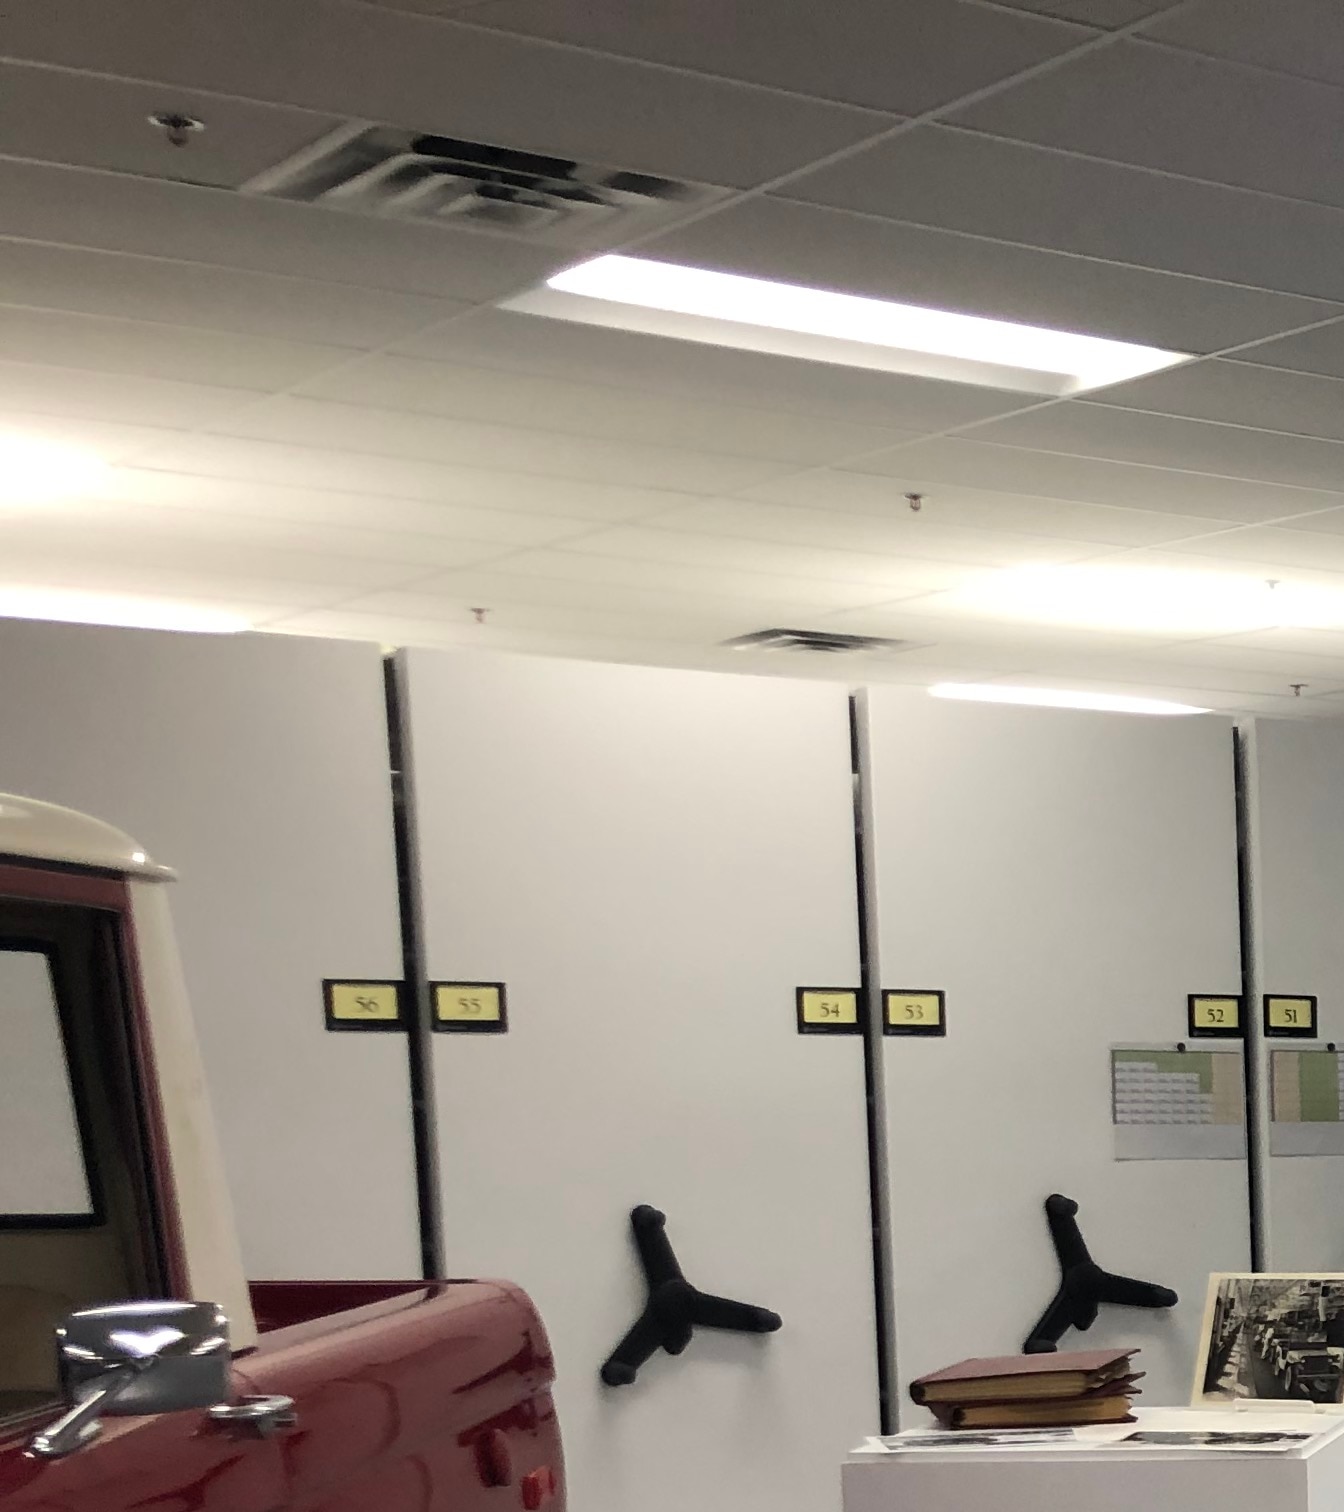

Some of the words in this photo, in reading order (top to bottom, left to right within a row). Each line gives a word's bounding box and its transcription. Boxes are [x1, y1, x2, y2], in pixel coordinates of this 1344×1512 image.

[820, 1002, 840, 1018] 54
[904, 1004, 924, 1020] 53
[1207, 1008, 1224, 1023] 52
[1285, 1008, 1297, 1023] 51
